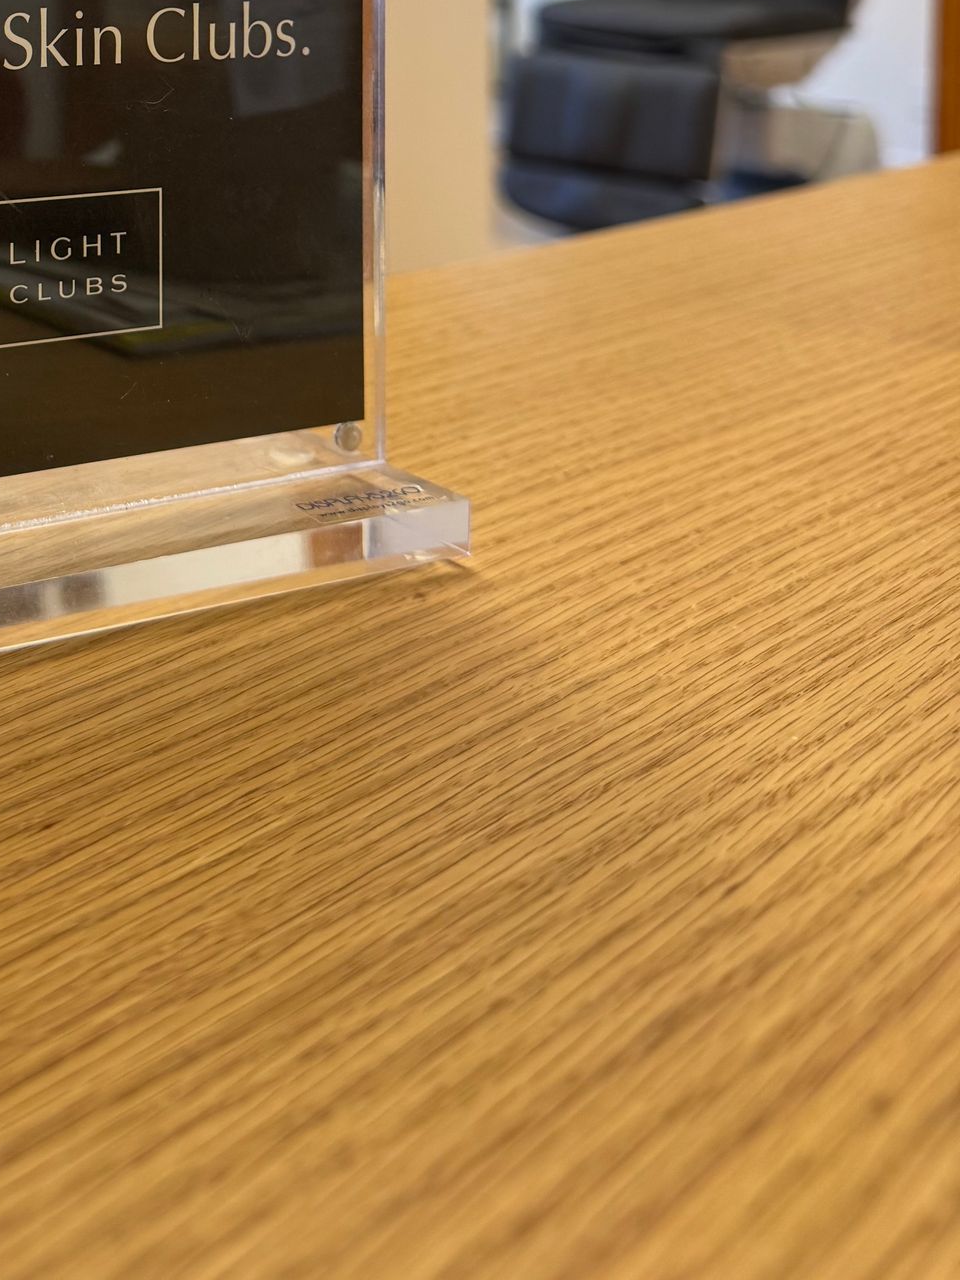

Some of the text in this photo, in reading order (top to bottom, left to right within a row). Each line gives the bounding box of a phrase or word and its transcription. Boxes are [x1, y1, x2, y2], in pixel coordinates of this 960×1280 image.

[3, 7, 122, 71] Skin
[146, 0, 311, 63] Clubs.
[9, 273, 128, 304] CLUBS
